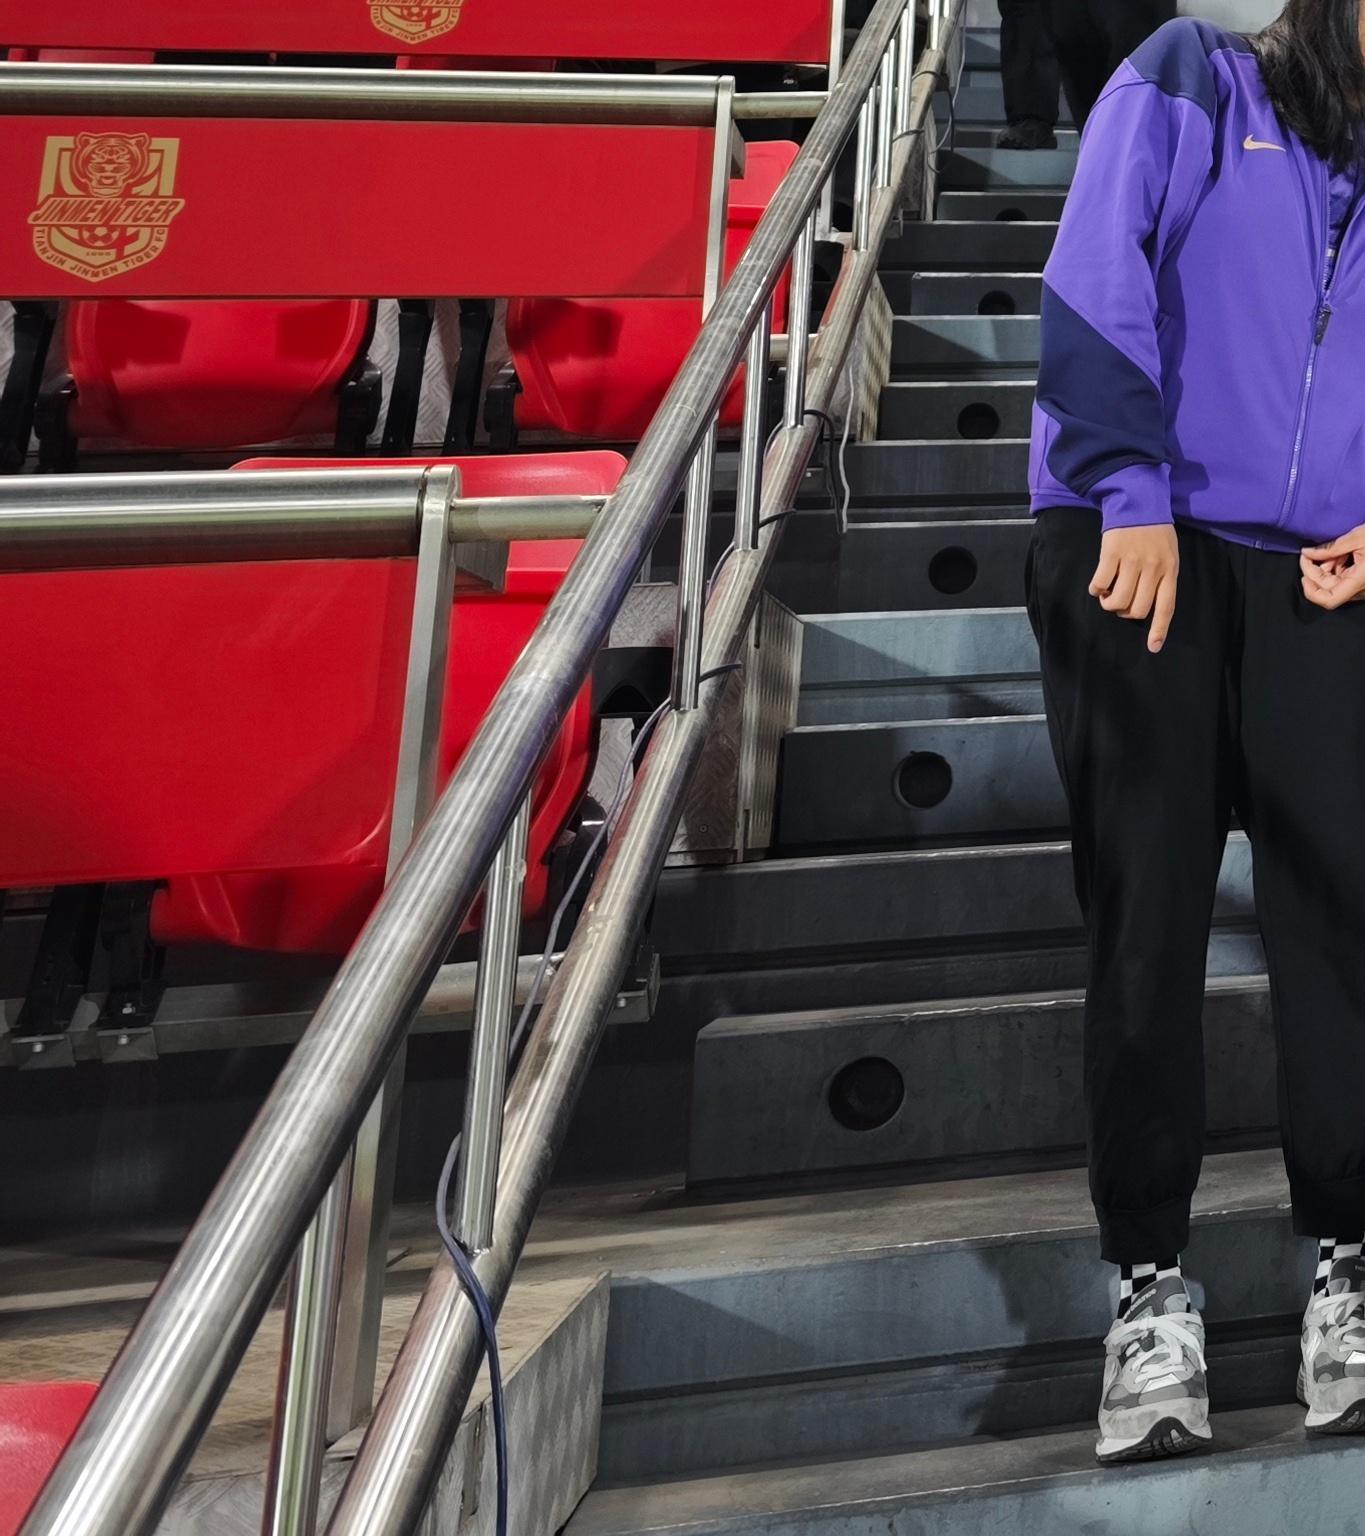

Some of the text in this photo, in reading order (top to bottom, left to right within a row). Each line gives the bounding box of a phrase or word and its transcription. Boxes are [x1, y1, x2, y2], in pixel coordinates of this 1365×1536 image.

[31, 199, 180, 224] JINMEN TIGER
[69, 262, 119, 279] JINMEN
